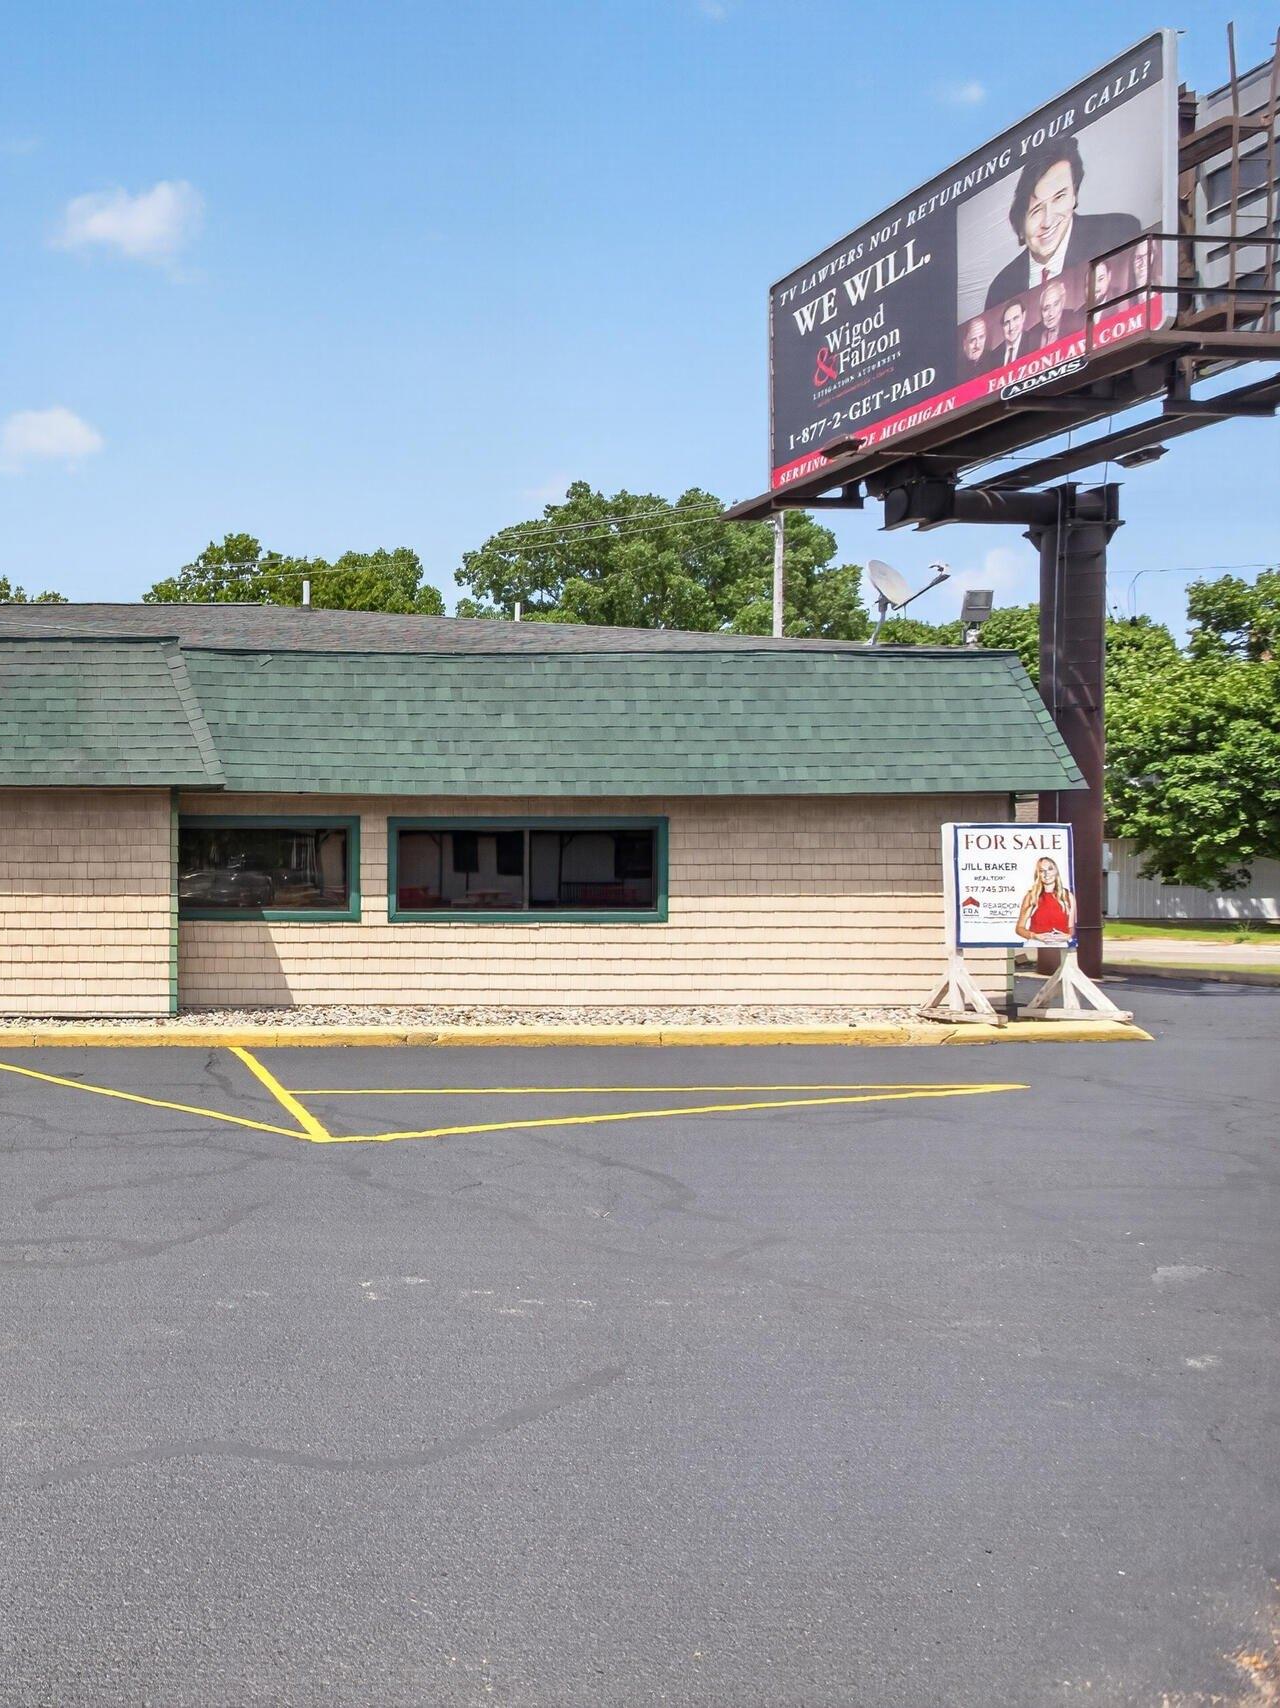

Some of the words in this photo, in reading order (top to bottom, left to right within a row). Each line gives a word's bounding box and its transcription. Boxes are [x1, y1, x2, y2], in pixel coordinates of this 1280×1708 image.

[780, 285, 797, 307] TV
[801, 243, 864, 294] LAWYERS
[869, 218, 901, 251] NOT
[906, 149, 1011, 228] RETURNING
[1020, 109, 1075, 157] YOUR
[1084, 60, 1151, 115] CALL?
[793, 288, 838, 336] WE
[843, 239, 931, 307] WILL.
[813, 347, 839, 387] &
[839, 328, 901, 375] Falzon
[825, 303, 885, 353] Wigod
[1009, 359, 1081, 396] ADAMS
[788, 367, 936, 450] 1-877-2-GET-PAID
[780, 456, 828, 484] SERVING
[880, 397, 956, 441] MICHIGAN
[961, 863, 982, 871] JILL
[984, 863, 1017, 871] BAKER
[965, 834, 1007, 850] FOR
[1013, 834, 1061, 850] SALE
